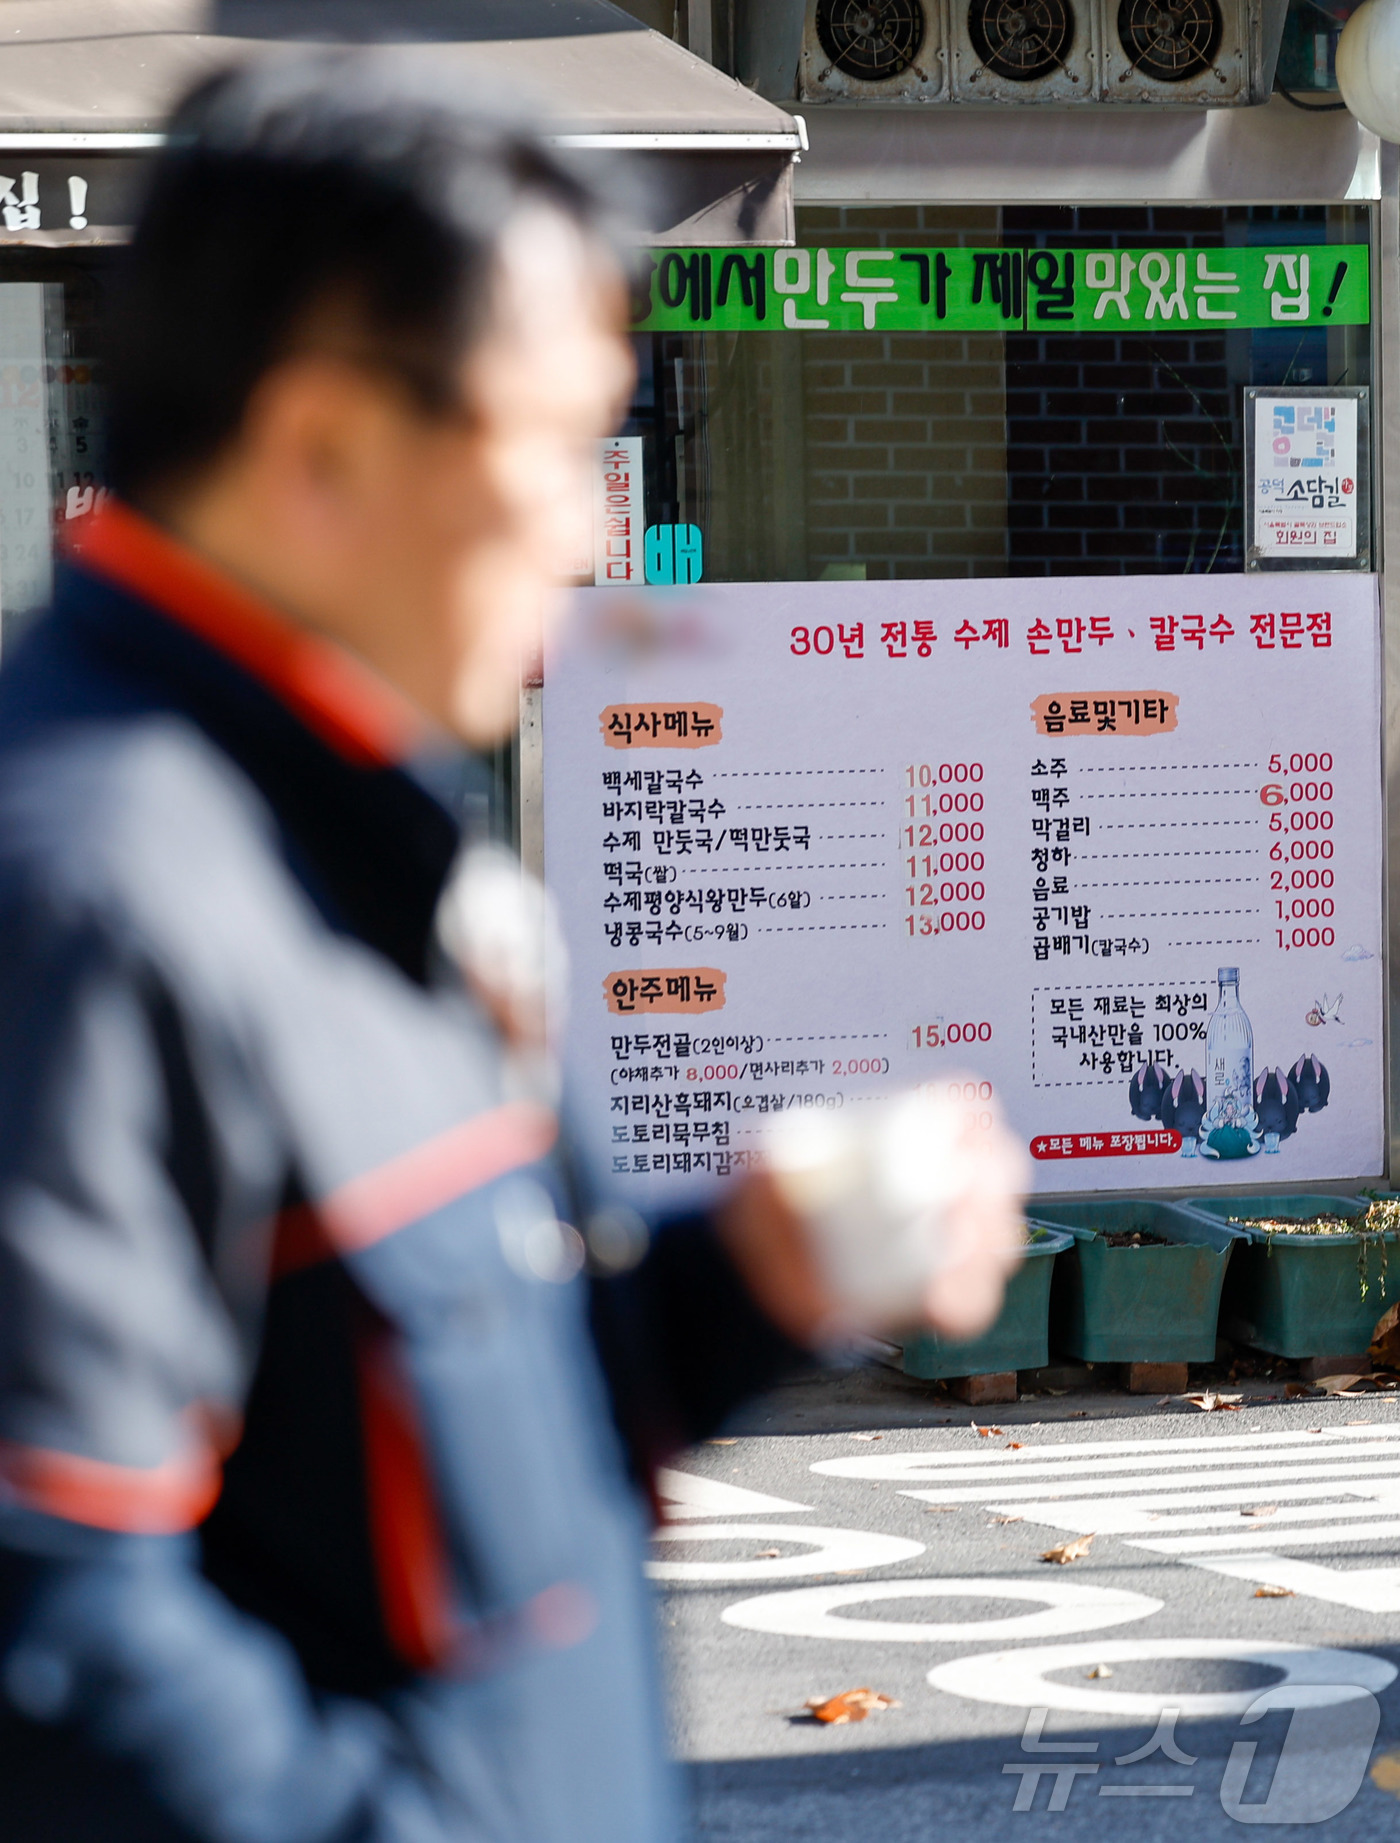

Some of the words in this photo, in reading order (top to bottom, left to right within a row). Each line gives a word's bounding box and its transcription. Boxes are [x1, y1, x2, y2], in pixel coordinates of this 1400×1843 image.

[76, 436, 87, 453] 5
[1275, 475, 1346, 508] 소담길
[1276, 531, 1316, 544] 회원의
[1324, 531, 1336, 544] 집
[791, 622, 864, 658] 30년
[881, 620, 937, 658] 전통
[954, 619, 1009, 650] 수제
[1150, 614, 1234, 651] 칼국수
[1250, 612, 1331, 649] 전문점
[608, 710, 715, 745] 식사메뉴
[1042, 698, 1169, 732] 음료및기타
[1031, 758, 1067, 778] 소주
[1268, 752, 1333, 775] 5,000
[602, 769, 703, 796] 백세칼국수
[905, 762, 984, 788] 10,000
[603, 798, 725, 824] 바지락칼국수
[905, 792, 985, 818] 11,000
[1032, 788, 1069, 812] 맥주
[1259, 781, 1334, 807] 6,000
[603, 831, 640, 852] 수제
[904, 822, 985, 848] 12,000
[1032, 817, 1089, 842] 막걸리
[1268, 811, 1334, 834] 5,000
[906, 851, 985, 878] 11,000
[1032, 847, 1071, 872] 청하
[1269, 839, 1334, 862] 6,000
[905, 881, 986, 907] 12,000
[1033, 876, 1069, 901] 음료
[1269, 869, 1334, 892] 2,000
[905, 910, 986, 936] 13,000
[1033, 905, 1091, 931] 공기밥
[1274, 898, 1335, 921] 1,000
[1275, 926, 1335, 950] 1,000
[612, 975, 718, 1010] 안주메뉴
[1050, 998, 1084, 1019] 모든
[1094, 996, 1146, 1018] 재료는
[1155, 993, 1207, 1016] 최상의
[911, 1021, 993, 1049] 15,000
[1052, 1023, 1143, 1048] 국내산만을
[1153, 1021, 1208, 1042] 100%
[832, 1057, 890, 1076] 2,000)
[1079, 1050, 1180, 1074] 사용합니다.
[611, 1120, 731, 1147] 도토리묵무침
[1049, 1136, 1074, 1154] 모든
[1079, 1136, 1104, 1151] 메뉴
[611, 1150, 771, 1176] 도토리돼지감자
